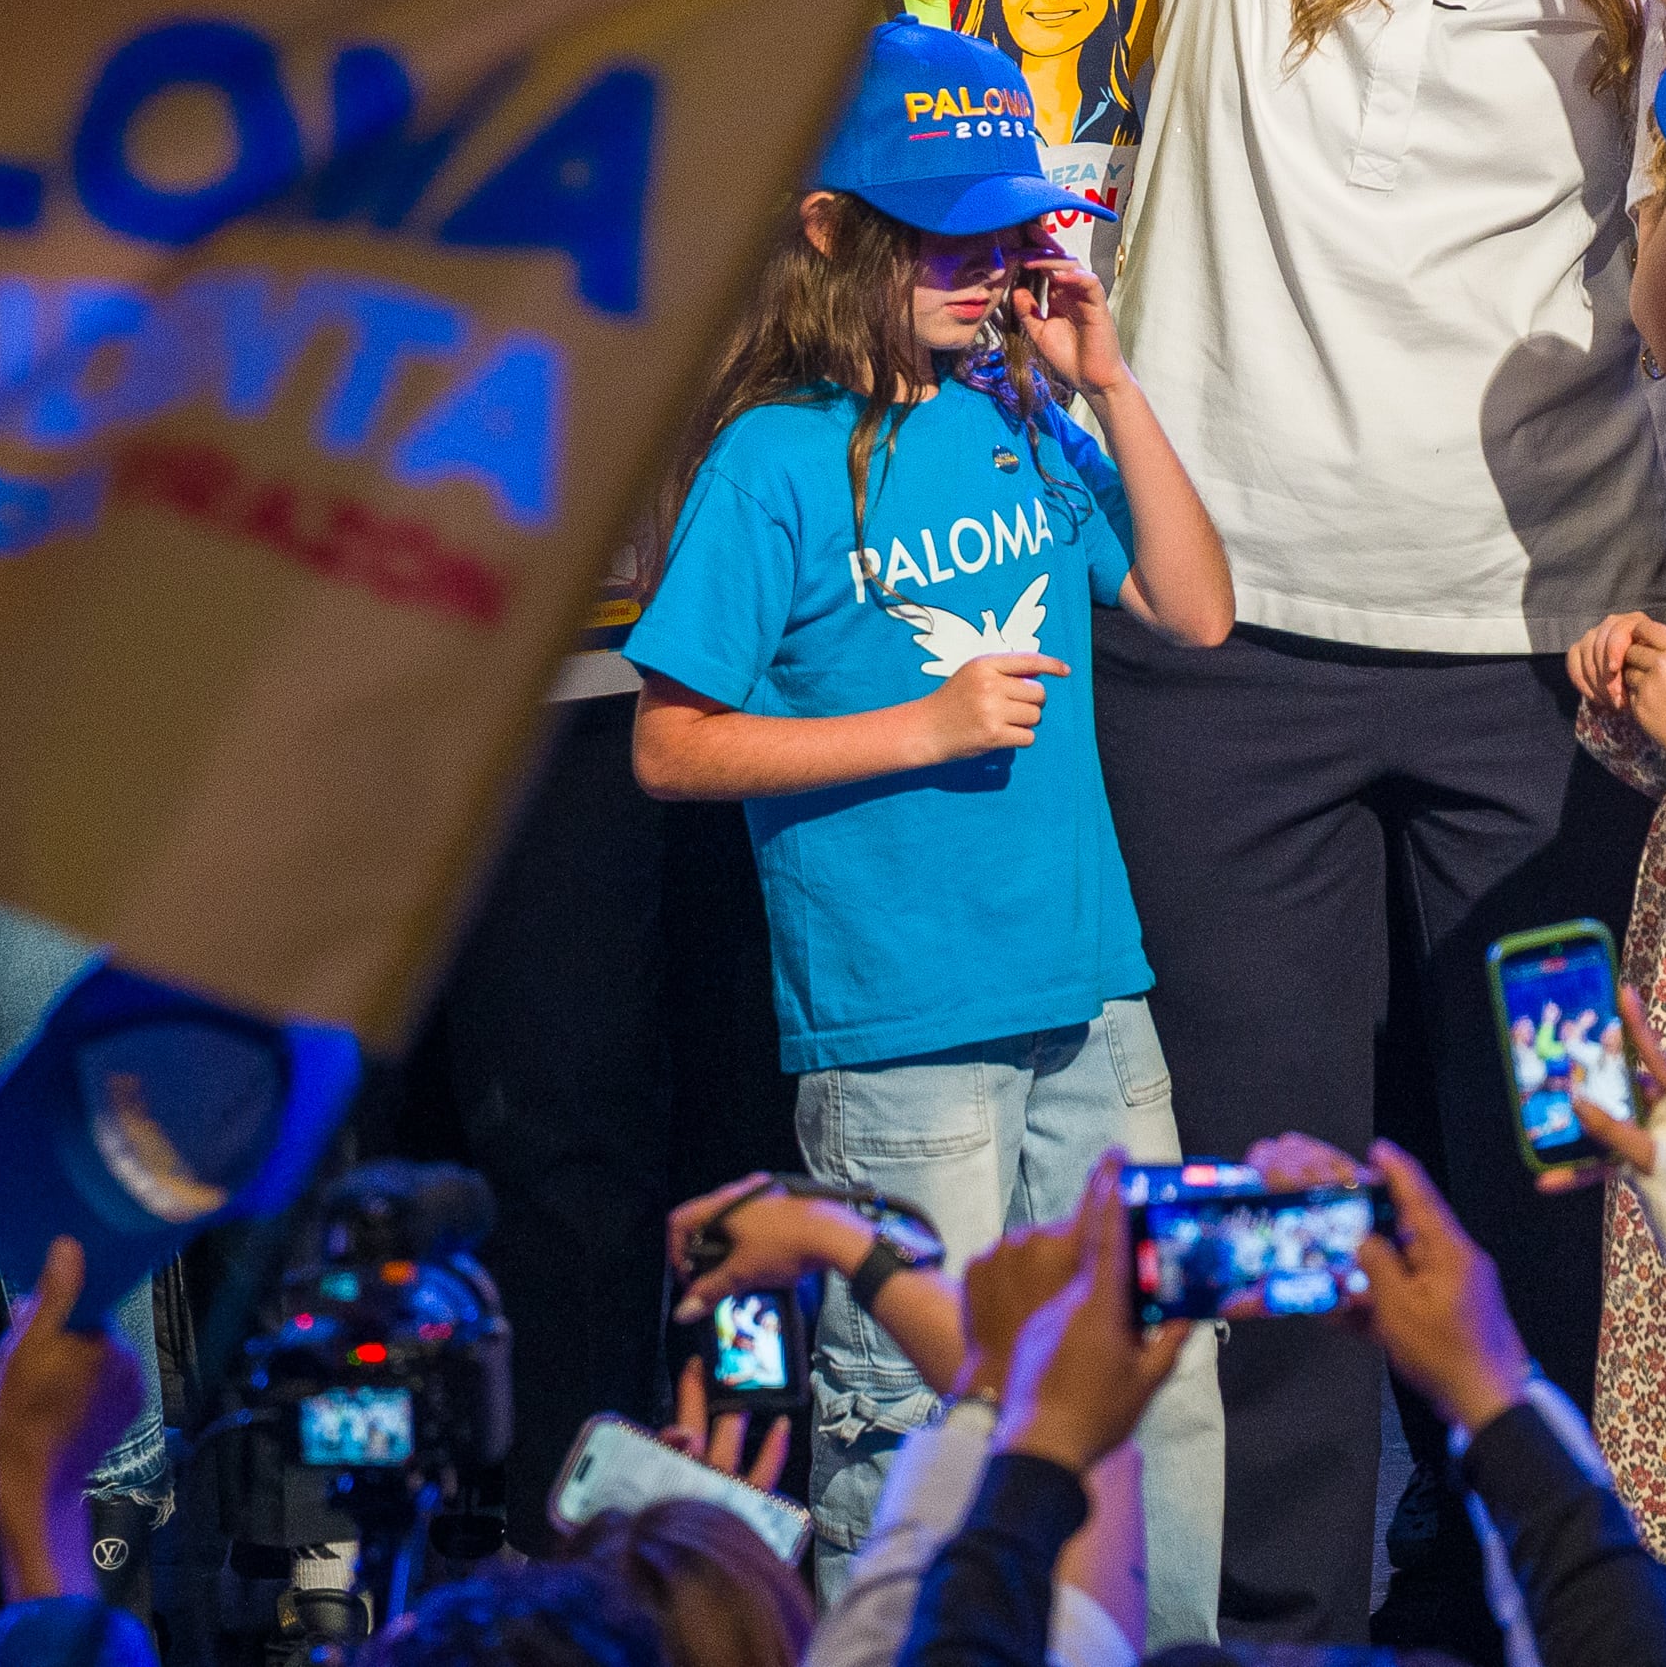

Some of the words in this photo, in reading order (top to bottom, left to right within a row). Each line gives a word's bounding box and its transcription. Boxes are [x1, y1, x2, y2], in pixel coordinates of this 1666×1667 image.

[904, 86, 1032, 124] PALOMA
[1106, 162, 1126, 181] Y
[847, 496, 1055, 606] PALOMA
